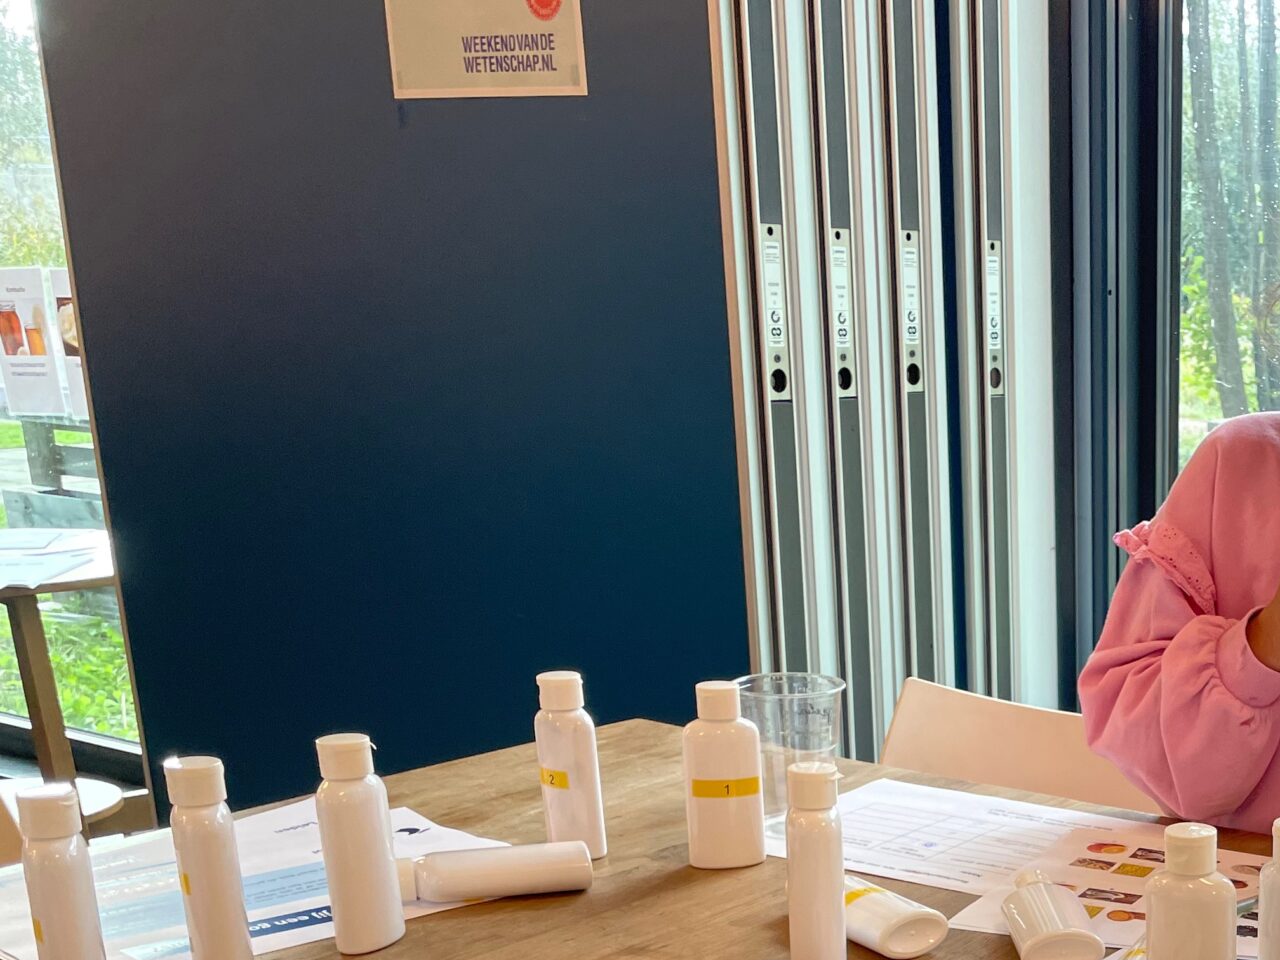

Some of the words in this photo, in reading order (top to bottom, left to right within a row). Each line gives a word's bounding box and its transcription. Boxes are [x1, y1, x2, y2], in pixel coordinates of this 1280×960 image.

[463, 54, 557, 73] WETENSCHAP.NL
[549, 774, 555, 785] 2
[723, 784, 730, 795] 1
